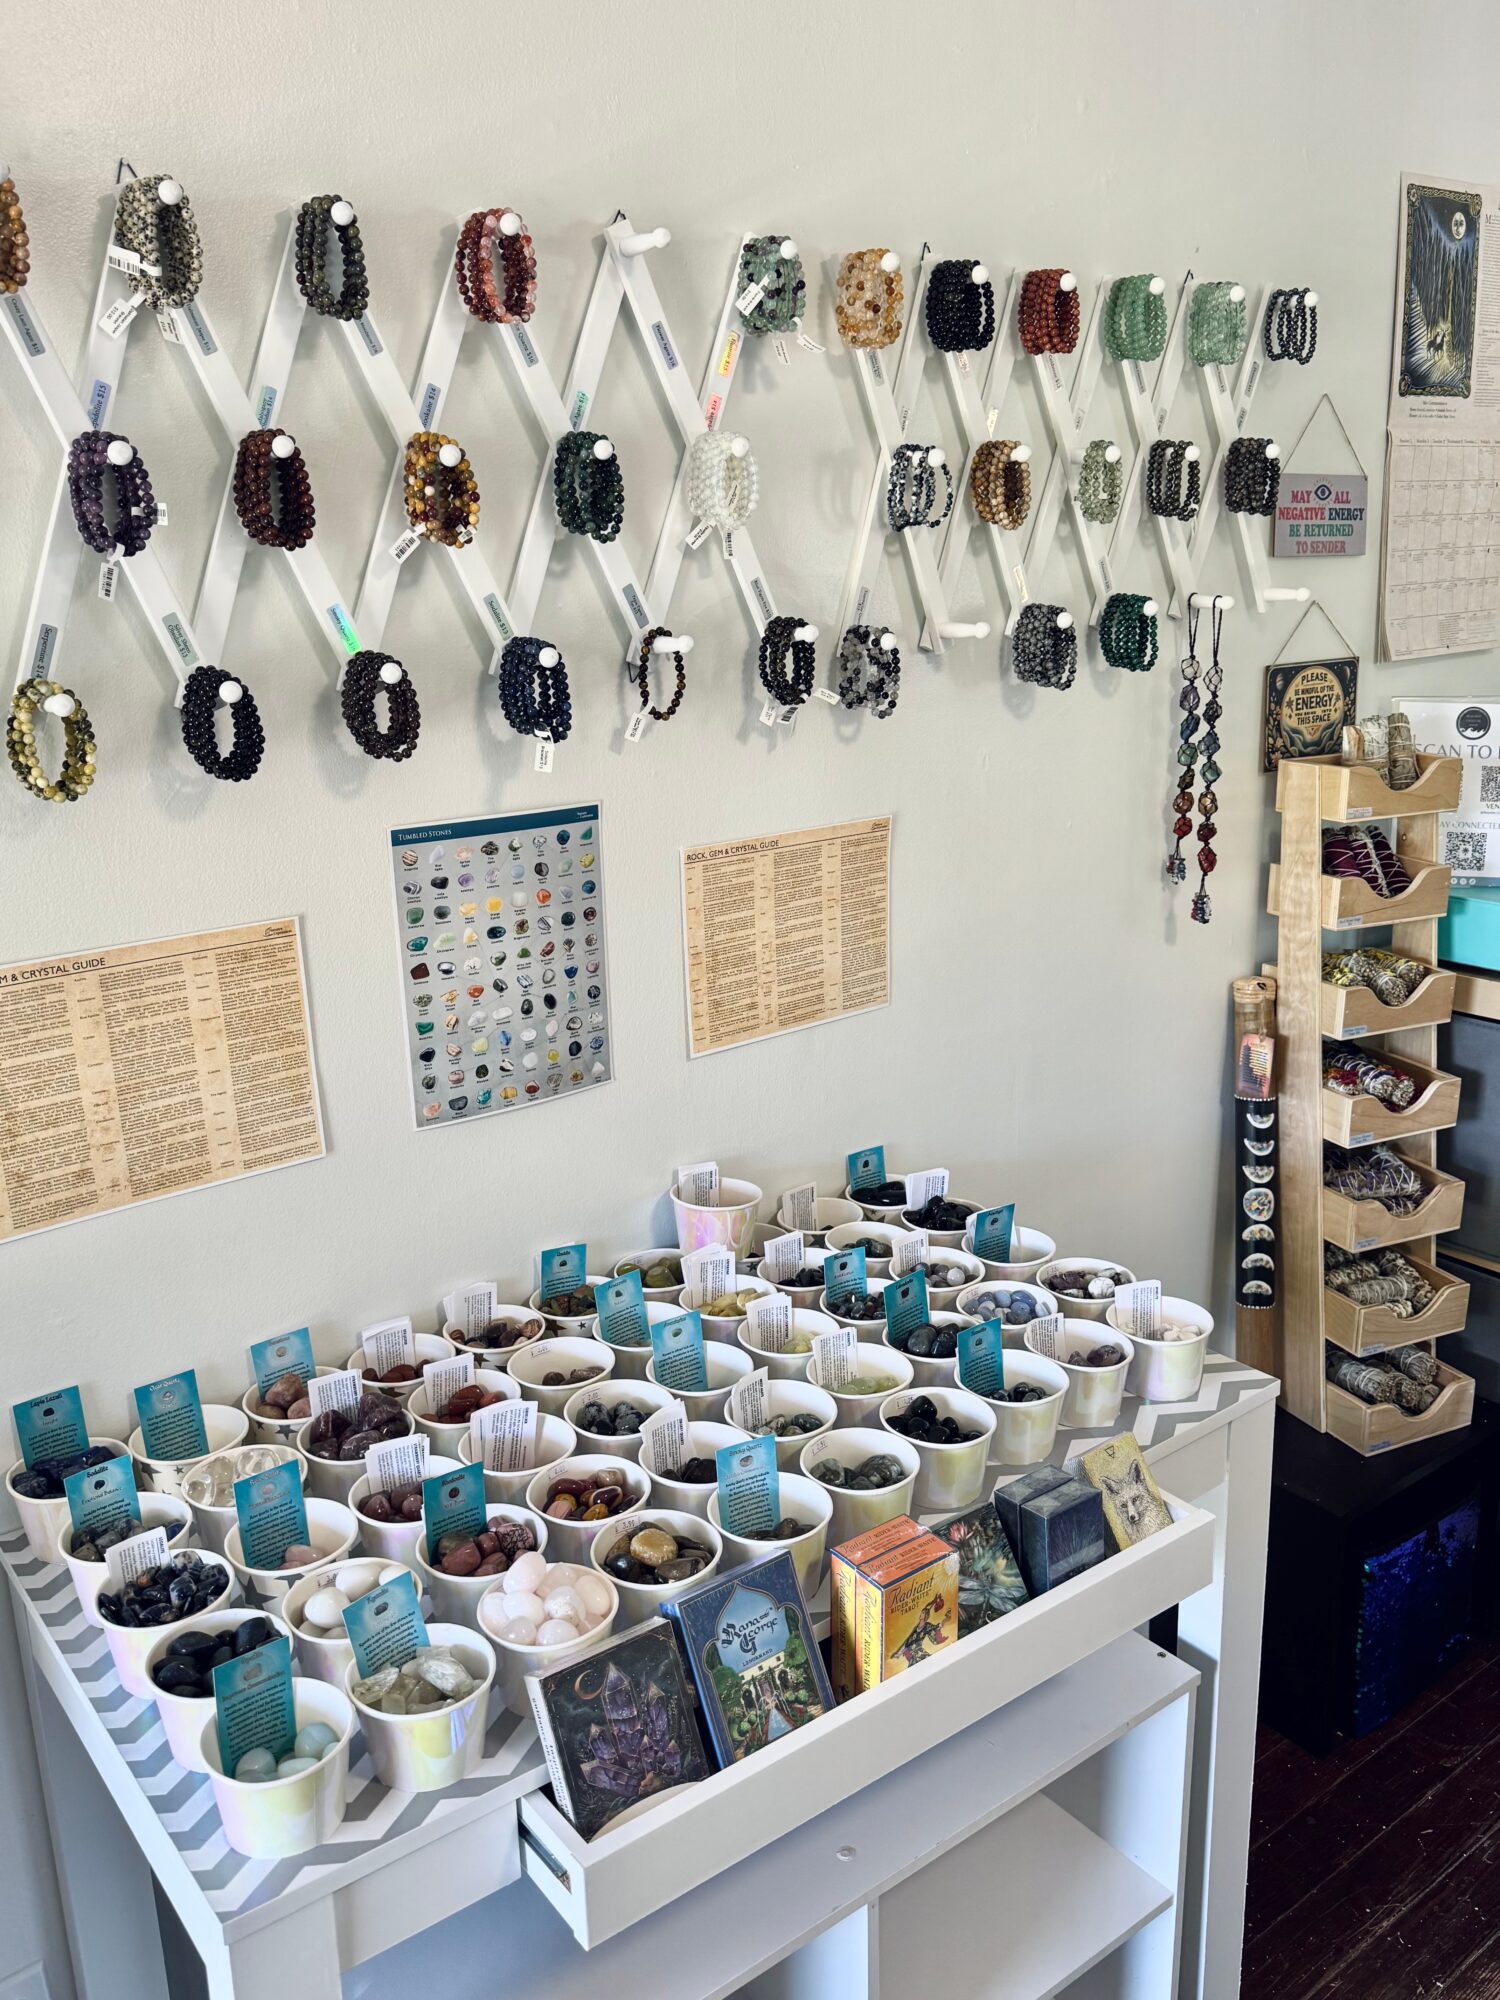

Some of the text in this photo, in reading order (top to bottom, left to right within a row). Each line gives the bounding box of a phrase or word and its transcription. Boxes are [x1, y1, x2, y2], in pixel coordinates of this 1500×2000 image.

[517, 331, 529, 351] Quartz
[427, 386, 436, 400] $14
[90, 384, 106, 429] pidolite $15
[573, 404, 582, 420] Agate
[1291, 490, 1351, 504] MAY ALL
[1278, 507, 1364, 521] NEGATIVE ENERGY
[1289, 524, 1353, 537] BE RETURNED
[1296, 540, 1346, 554] TO SENDER
[487, 599, 509, 635] Sodalite $13
[167, 623, 182, 648] Obsidian
[172, 622, 184, 639] Silver
[34, 626, 53, 679] Serpentine $14
[1301, 673, 1328, 684] PLEASE
[1301, 687, 1319, 695] MINDFUL
[1320, 686, 1326, 694] OF
[1295, 693, 1334, 711] ENERGY
[1297, 714, 1331, 725] THIS SPACE
[1467, 745, 1492, 759] TO
[398, 829, 452, 841] TUMBLED STONES
[686, 839, 780, 862] ROCK, GEM & CRYSTAL GUIDE
[11, 973, 19, 983] &
[21, 965, 70, 981] CRYSTAL
[72, 956, 106, 972] GUIDE
[30, 1393, 62, 1408] Lapis Lazuli
[728, 1442, 762, 1457] Smoky Quartz
[86, 1464, 108, 1478] Sodalite
[840, 1519, 910, 1553] Radiant RIDER-WAITE
[866, 1537, 937, 1573] Radiant RIDER-WAITE
[888, 1572, 934, 1608] Radiant
[891, 1591, 929, 1613] RIDER-WAITE
[901, 1603, 919, 1615] TAROT
[721, 1617, 760, 1648] Rana
[740, 1618, 778, 1655] George
[742, 1648, 772, 1666] LENORMAND
